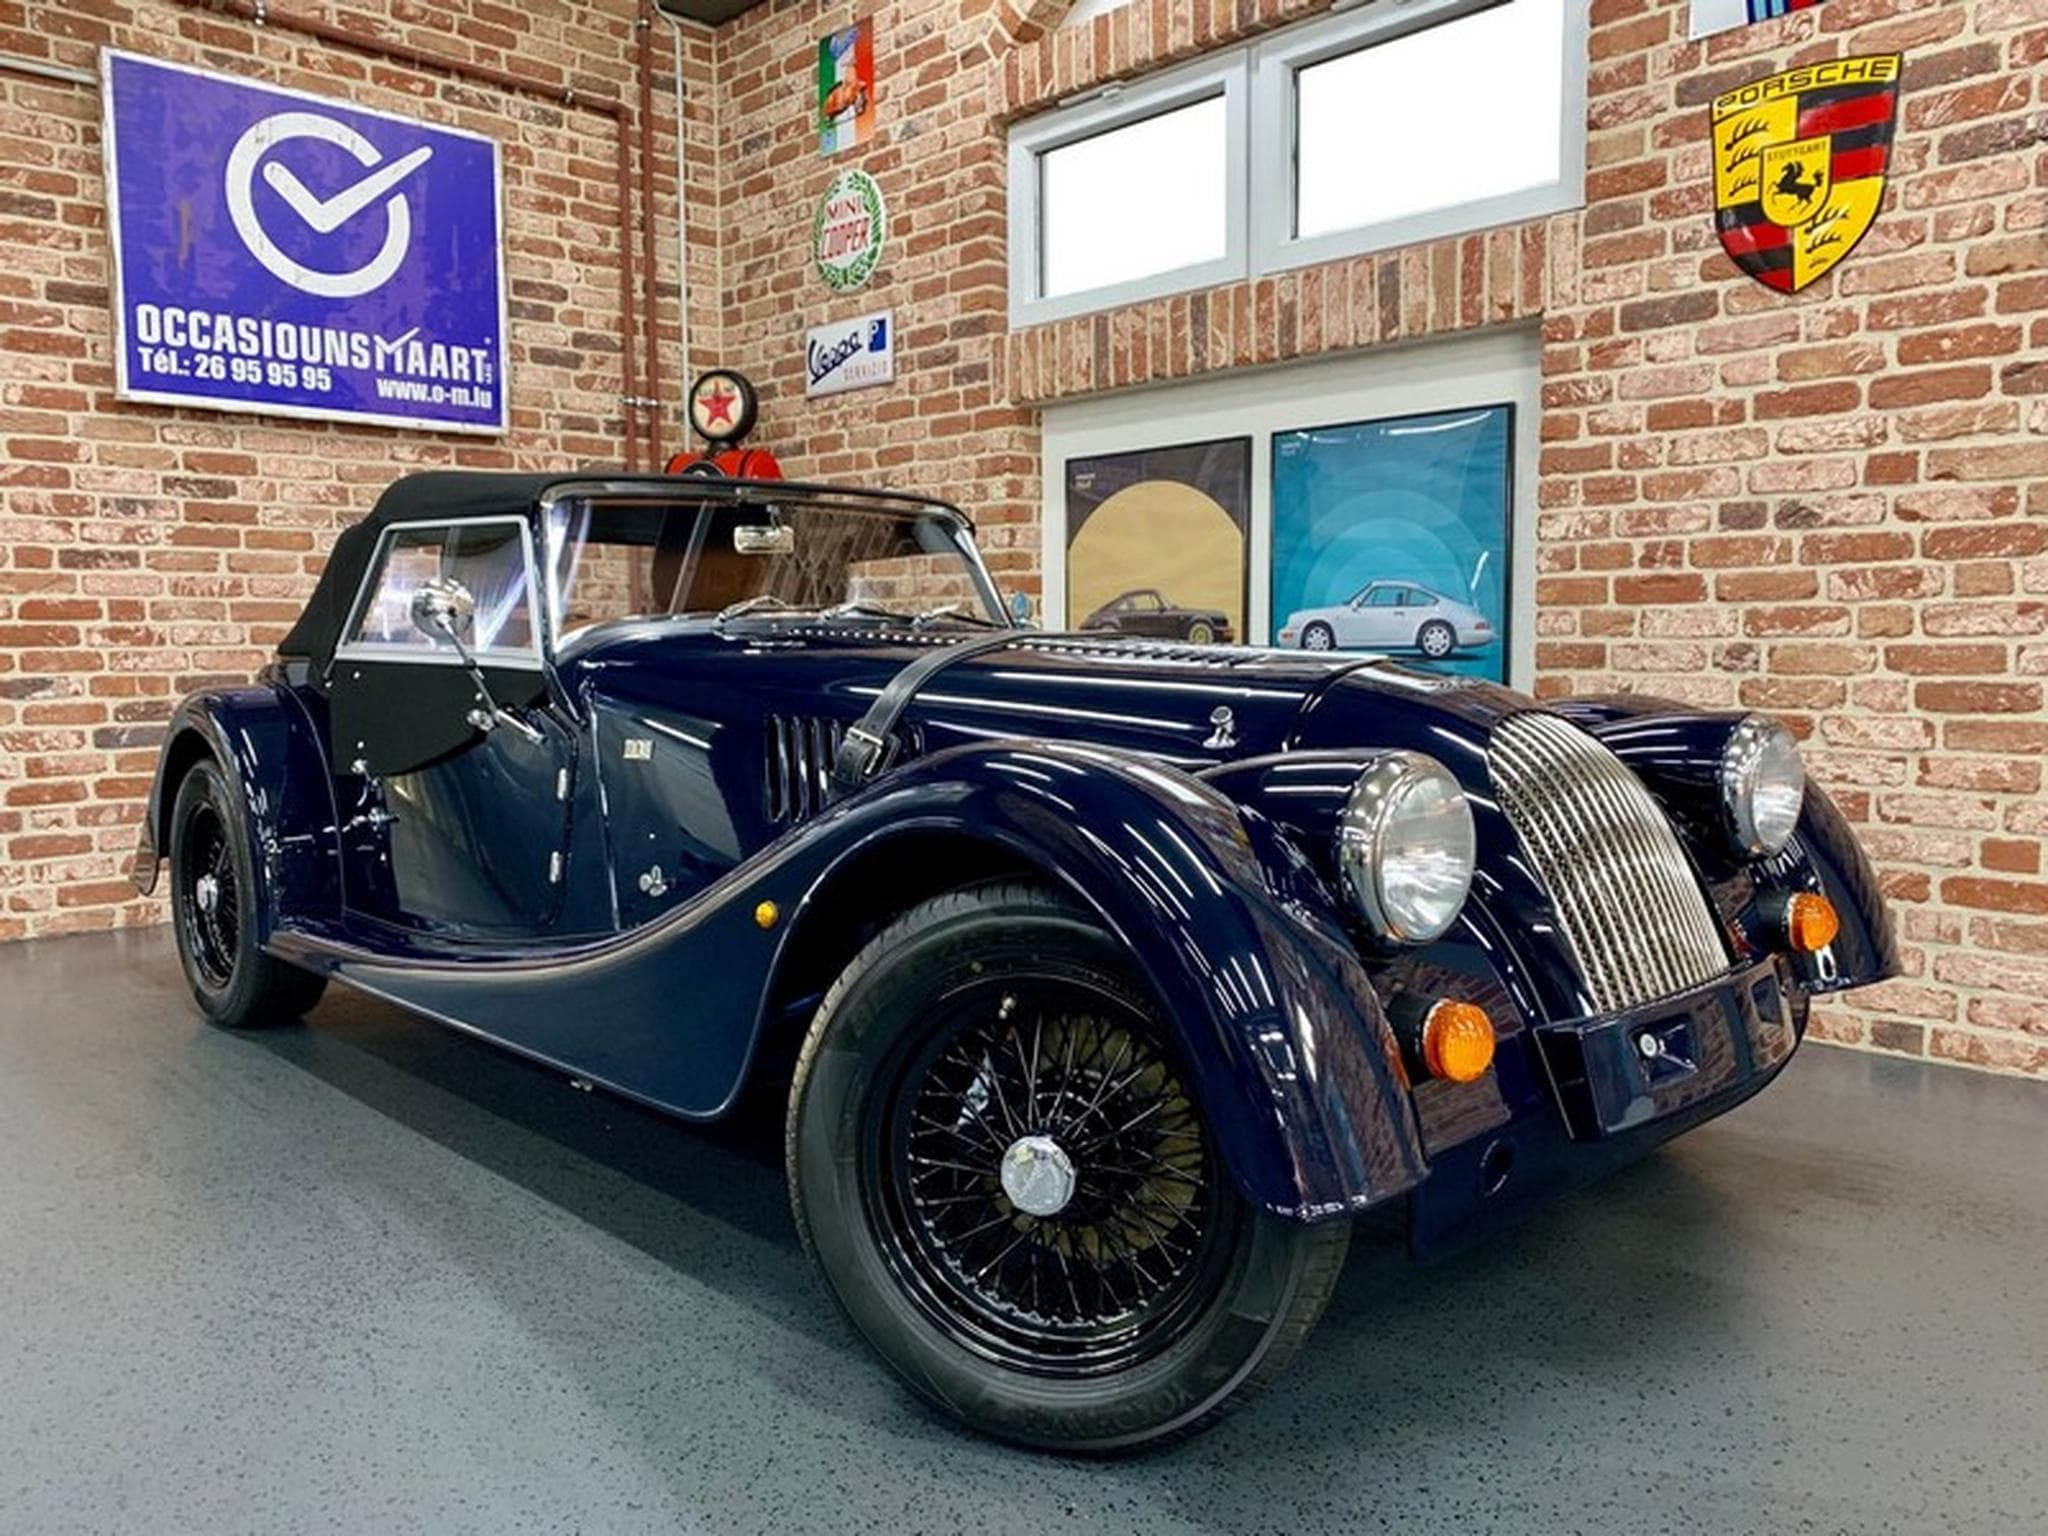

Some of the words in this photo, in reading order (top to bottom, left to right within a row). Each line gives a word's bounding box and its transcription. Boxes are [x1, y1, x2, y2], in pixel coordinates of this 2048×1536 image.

[1716, 59, 1895, 116] PORSCHE
[138, 346, 191, 376] Tél.:
[194, 353, 226, 380] 26
[230, 357, 262, 384] 95
[266, 362, 298, 388] 95
[301, 365, 332, 391] 95
[808, 331, 863, 386] Vespa
[376, 378, 493, 409] www.o-m.lu
